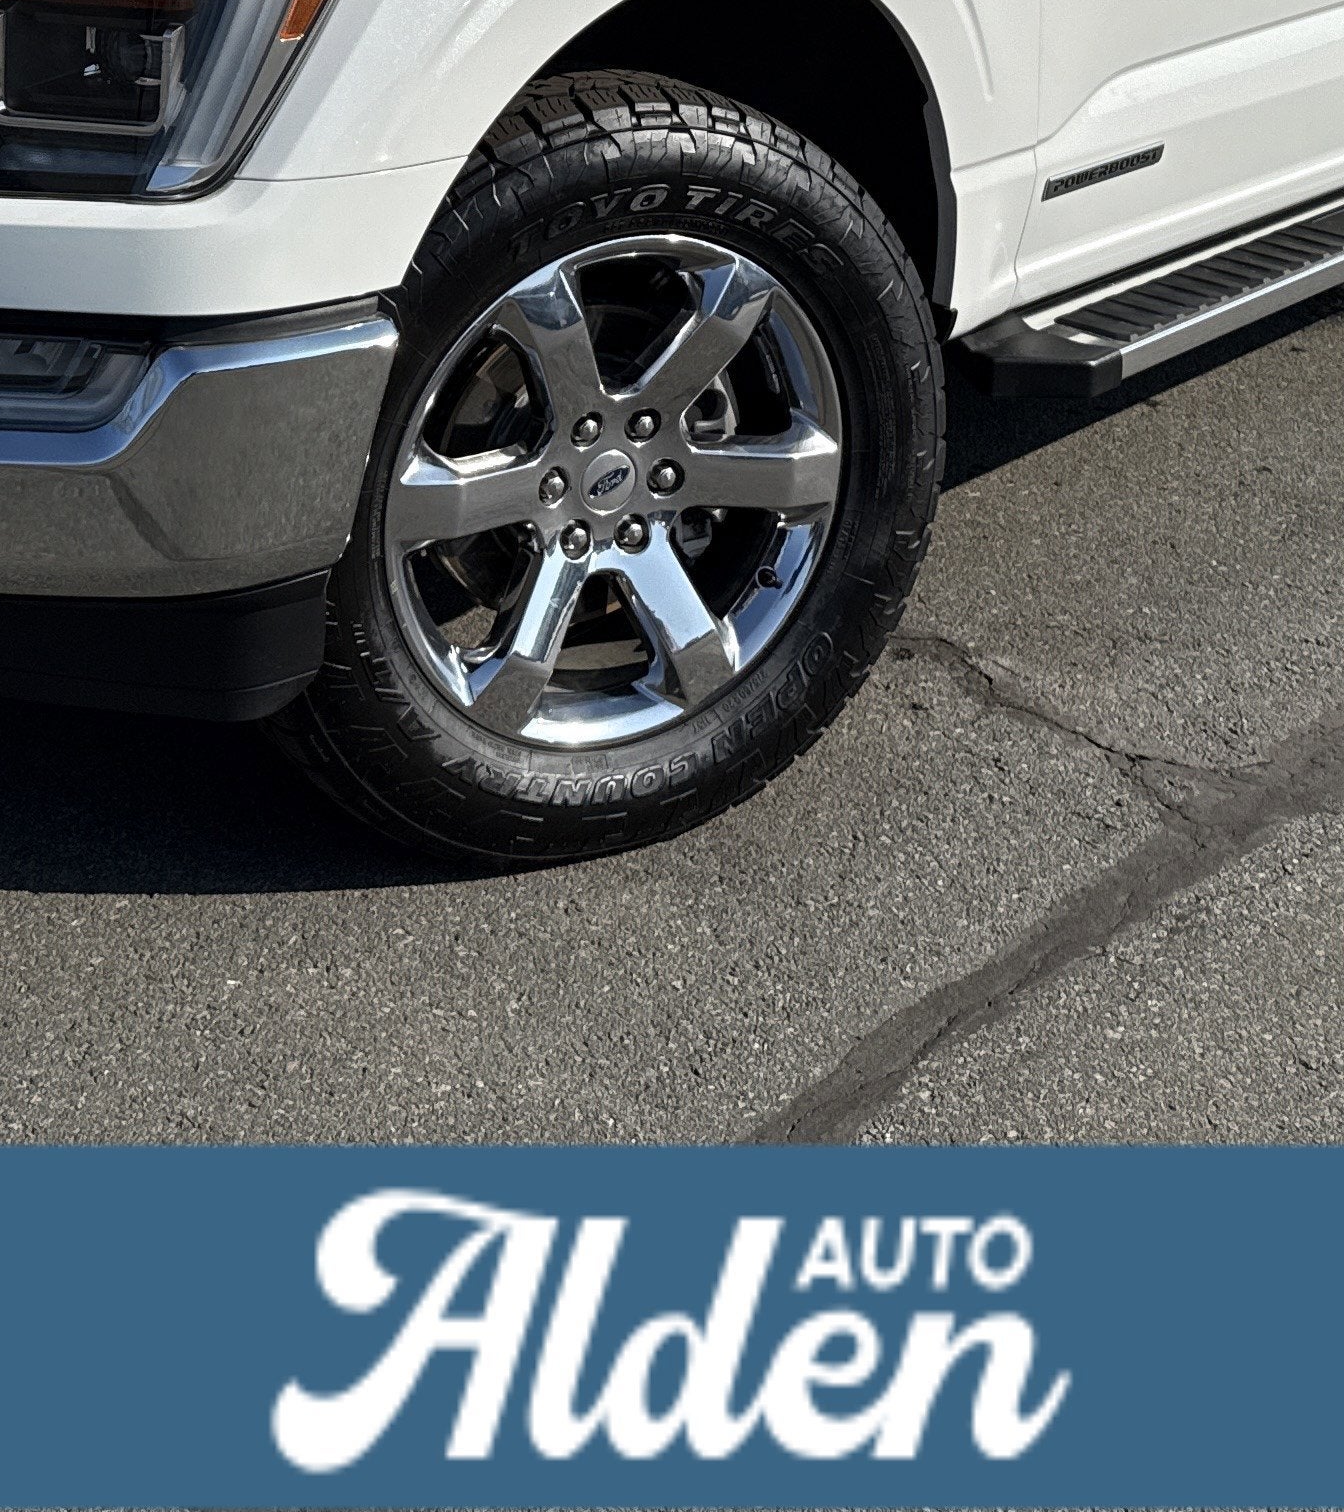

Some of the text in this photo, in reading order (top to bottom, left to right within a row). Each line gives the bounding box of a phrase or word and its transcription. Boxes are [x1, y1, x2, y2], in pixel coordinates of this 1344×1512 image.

[1053, 148, 1158, 193] POWERBOOST
[682, 184, 845, 276] TIRES
[596, 469, 624, 497] Ford
[442, 751, 702, 808] COUNTRY
